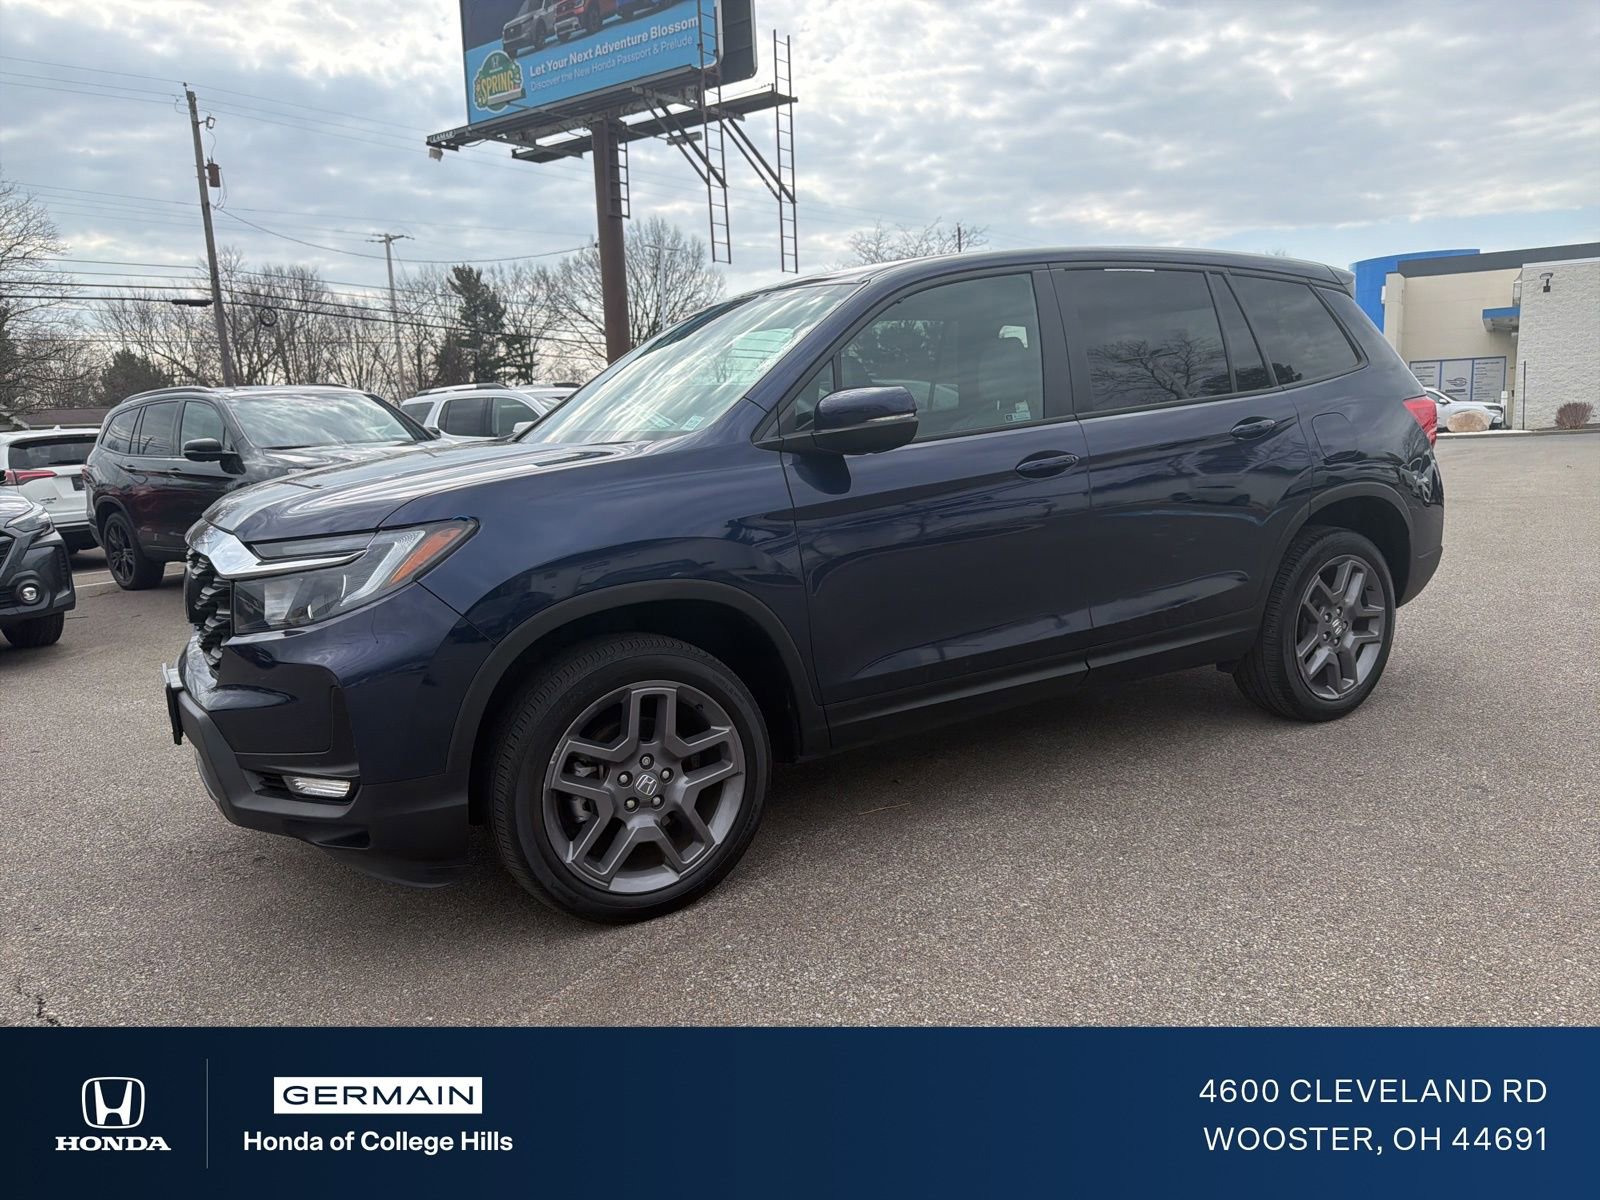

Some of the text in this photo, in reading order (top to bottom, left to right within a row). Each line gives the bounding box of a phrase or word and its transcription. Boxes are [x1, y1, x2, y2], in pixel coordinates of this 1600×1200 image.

[530, 16, 698, 77] Let Your Next Adventure Blossom
[530, 35, 693, 91] Discover the New Honda Passport & Prelude
[481, 70, 514, 104] SPRING
